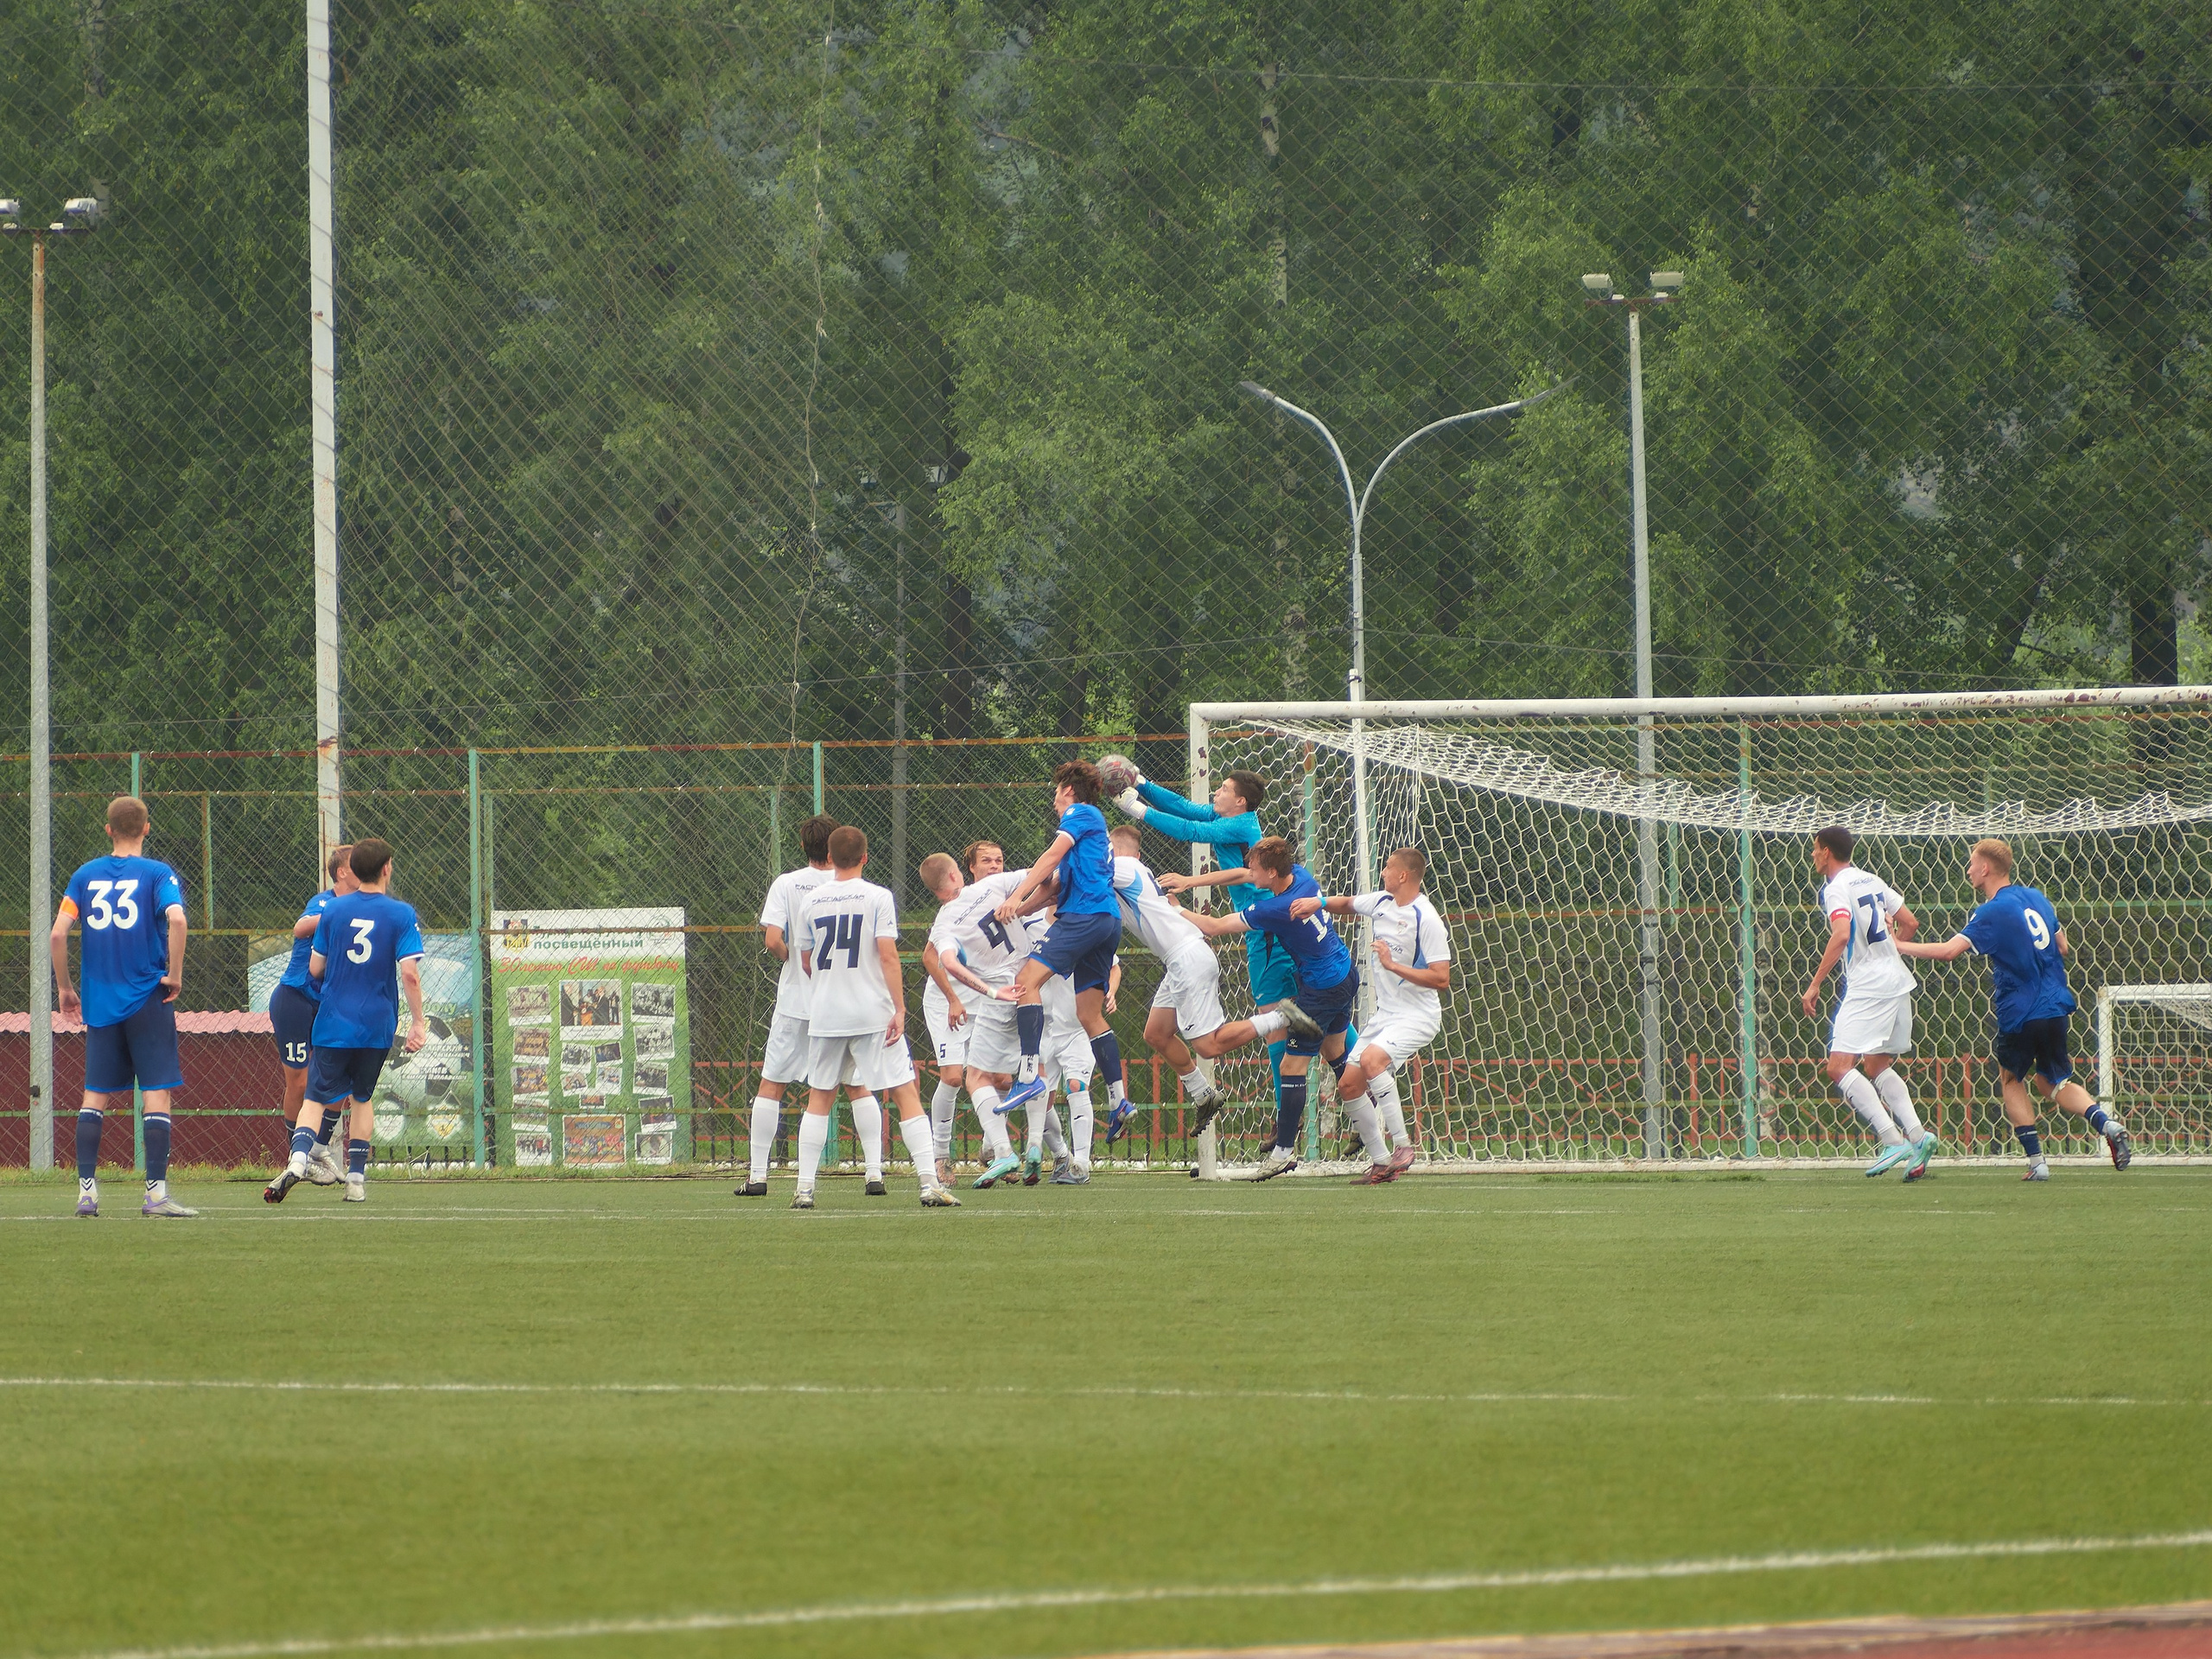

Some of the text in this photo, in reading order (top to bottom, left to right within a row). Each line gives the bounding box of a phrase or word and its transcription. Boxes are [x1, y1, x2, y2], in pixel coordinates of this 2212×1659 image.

[86, 879, 138, 930] 33
[346, 918, 375, 964] 3
[814, 913, 864, 970] 24
[977, 908, 1015, 955] 9
[2024, 907, 2050, 950] 9
[286, 1042, 307, 1063] 15
[939, 1043, 946, 1058] 5
